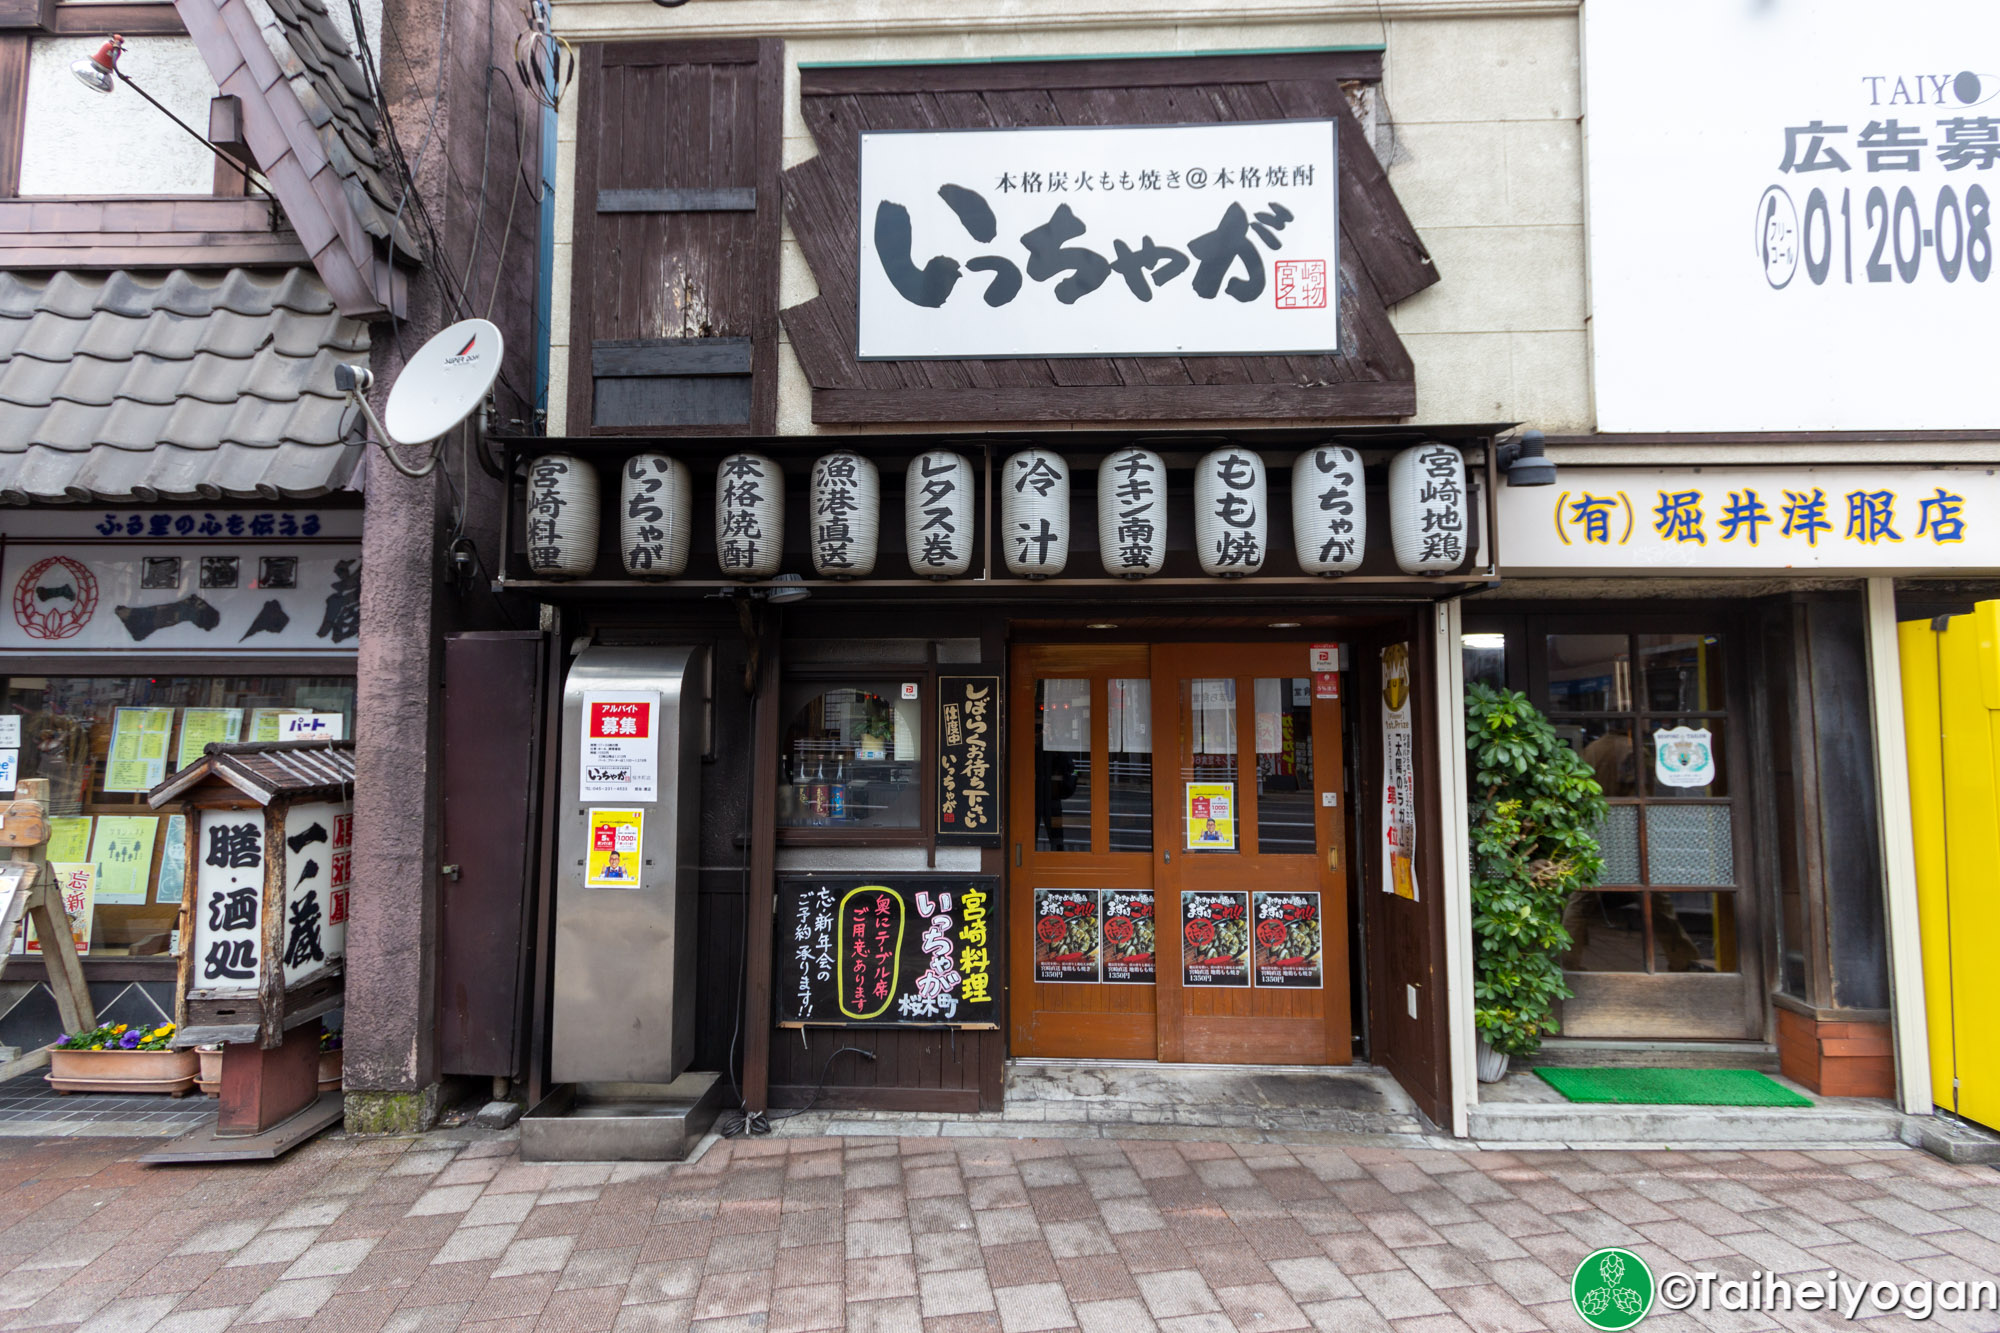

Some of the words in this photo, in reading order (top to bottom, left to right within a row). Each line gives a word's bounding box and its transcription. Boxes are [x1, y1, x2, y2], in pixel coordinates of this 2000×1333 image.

[995, 164, 1315, 193] 本格炭火もも焼き@本格焼酎
[875, 183, 1294, 308] いっちゃが
[95, 513, 321, 536] ふる里の心を伝える
[527, 458, 568, 570] 宮崎料理
[628, 458, 668, 570] いっちゃが
[722, 456, 765, 569] 本格焼酎
[816, 456, 859, 569] 漁港直送
[919, 456, 958, 567] レタス巻
[1015, 458, 1063, 564] 冷汁
[1113, 453, 1155, 568] チキン南蛮
[1215, 454, 1260, 566] もも焼
[1314, 450, 1354, 563] いっちゃが
[1418, 447, 1463, 562] 宮崎地鶏
[289, 717, 326, 731] パート
[601, 705, 638, 713] アルバイト
[601, 717, 637, 735] 募集
[960, 683, 990, 829] しばらくお待ち下さい
[588, 768, 627, 781] いっちゃが
[942, 754, 957, 814] いっちゃが
[851, 907, 871, 1013] ご用意あります
[872, 894, 893, 1000] 奥にテーブル席
[915, 891, 962, 998] いっちゃが
[958, 888, 992, 1003] 宮崎料理
[898, 992, 959, 1018] 桜木町
